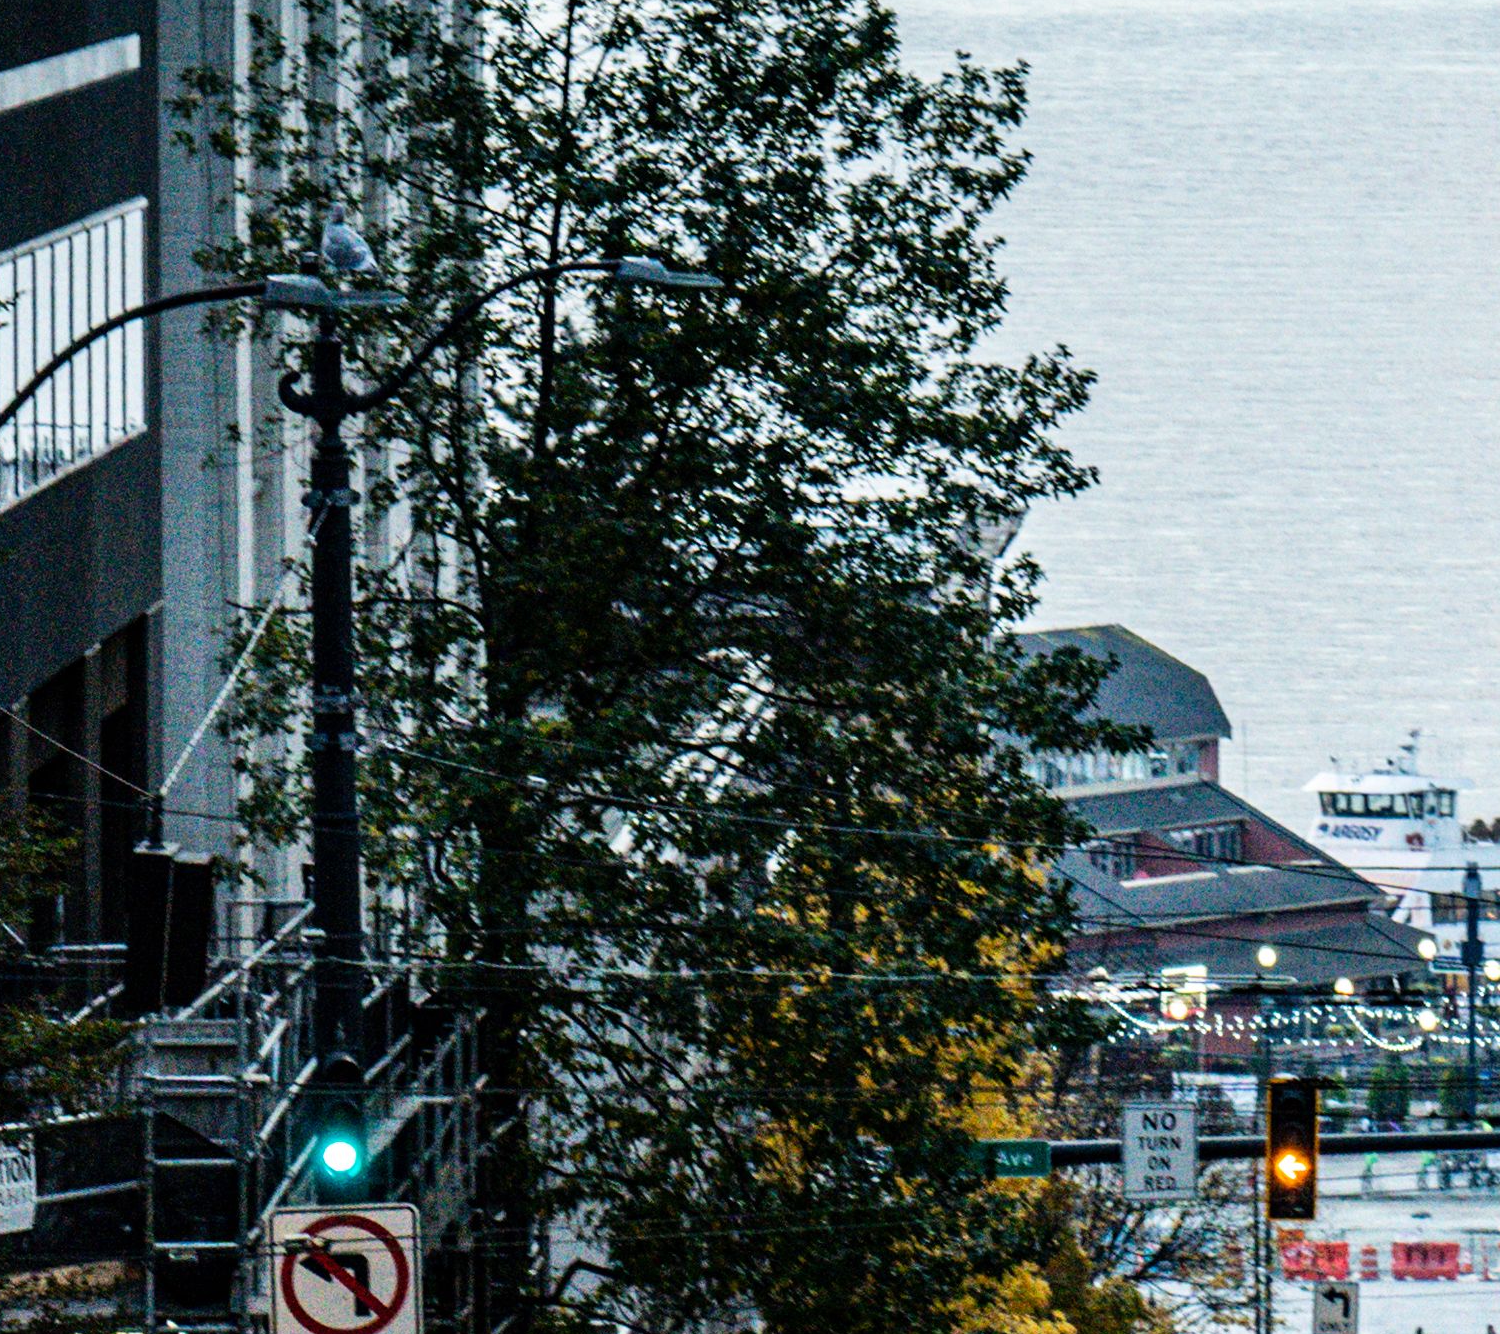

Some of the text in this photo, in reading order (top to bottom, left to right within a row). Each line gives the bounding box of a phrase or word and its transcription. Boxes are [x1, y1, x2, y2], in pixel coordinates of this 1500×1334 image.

[1142, 1113, 1176, 1131] NO
[1138, 1137, 1181, 1151] TURN
[1148, 1156, 1170, 1170] ON
[1145, 1176, 1175, 1190] RED
